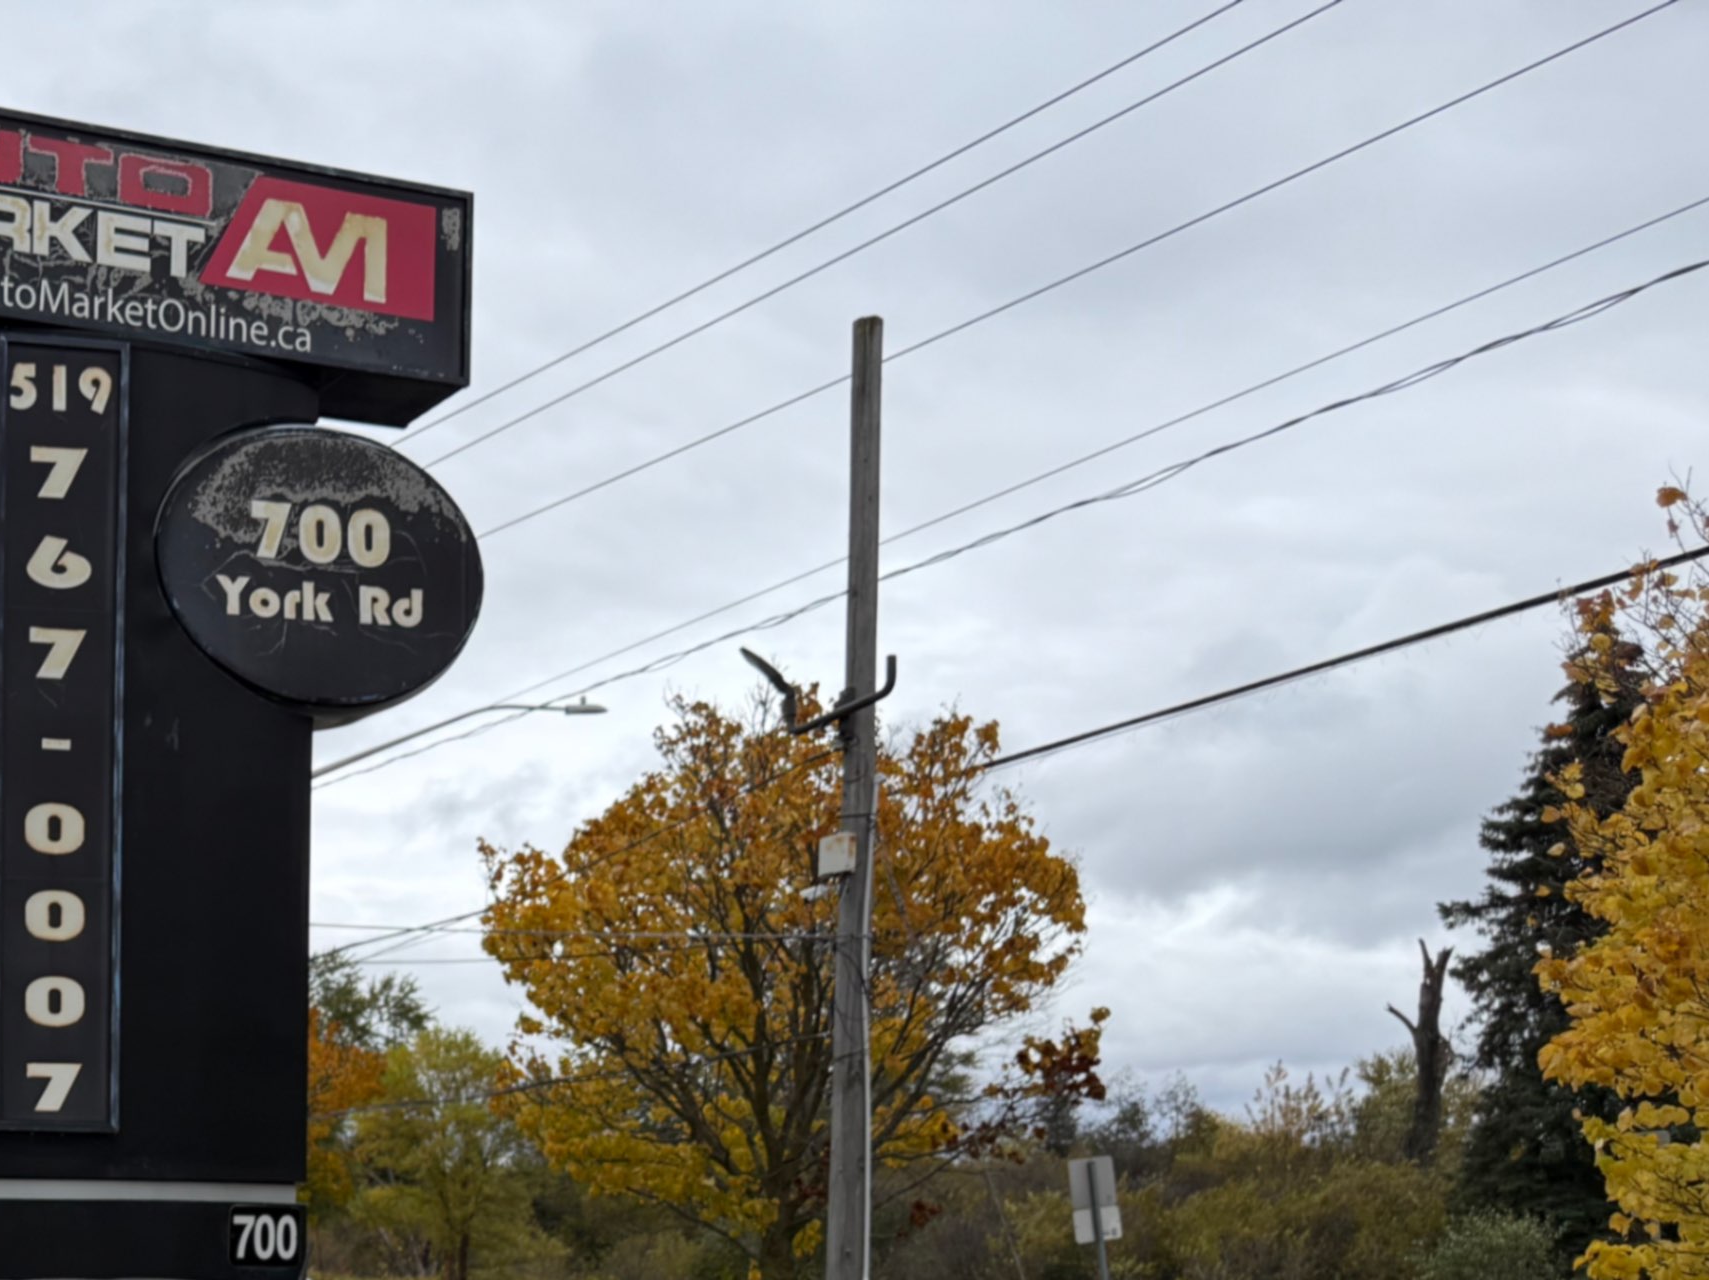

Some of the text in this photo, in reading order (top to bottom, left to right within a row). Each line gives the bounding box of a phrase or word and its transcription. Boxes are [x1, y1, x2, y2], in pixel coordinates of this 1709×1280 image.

[224, 198, 387, 304] AM
[9, 362, 113, 415] 519
[250, 499, 391, 568] 700
[215, 573, 424, 628] York Rd
[233, 1213, 298, 1260] 700
